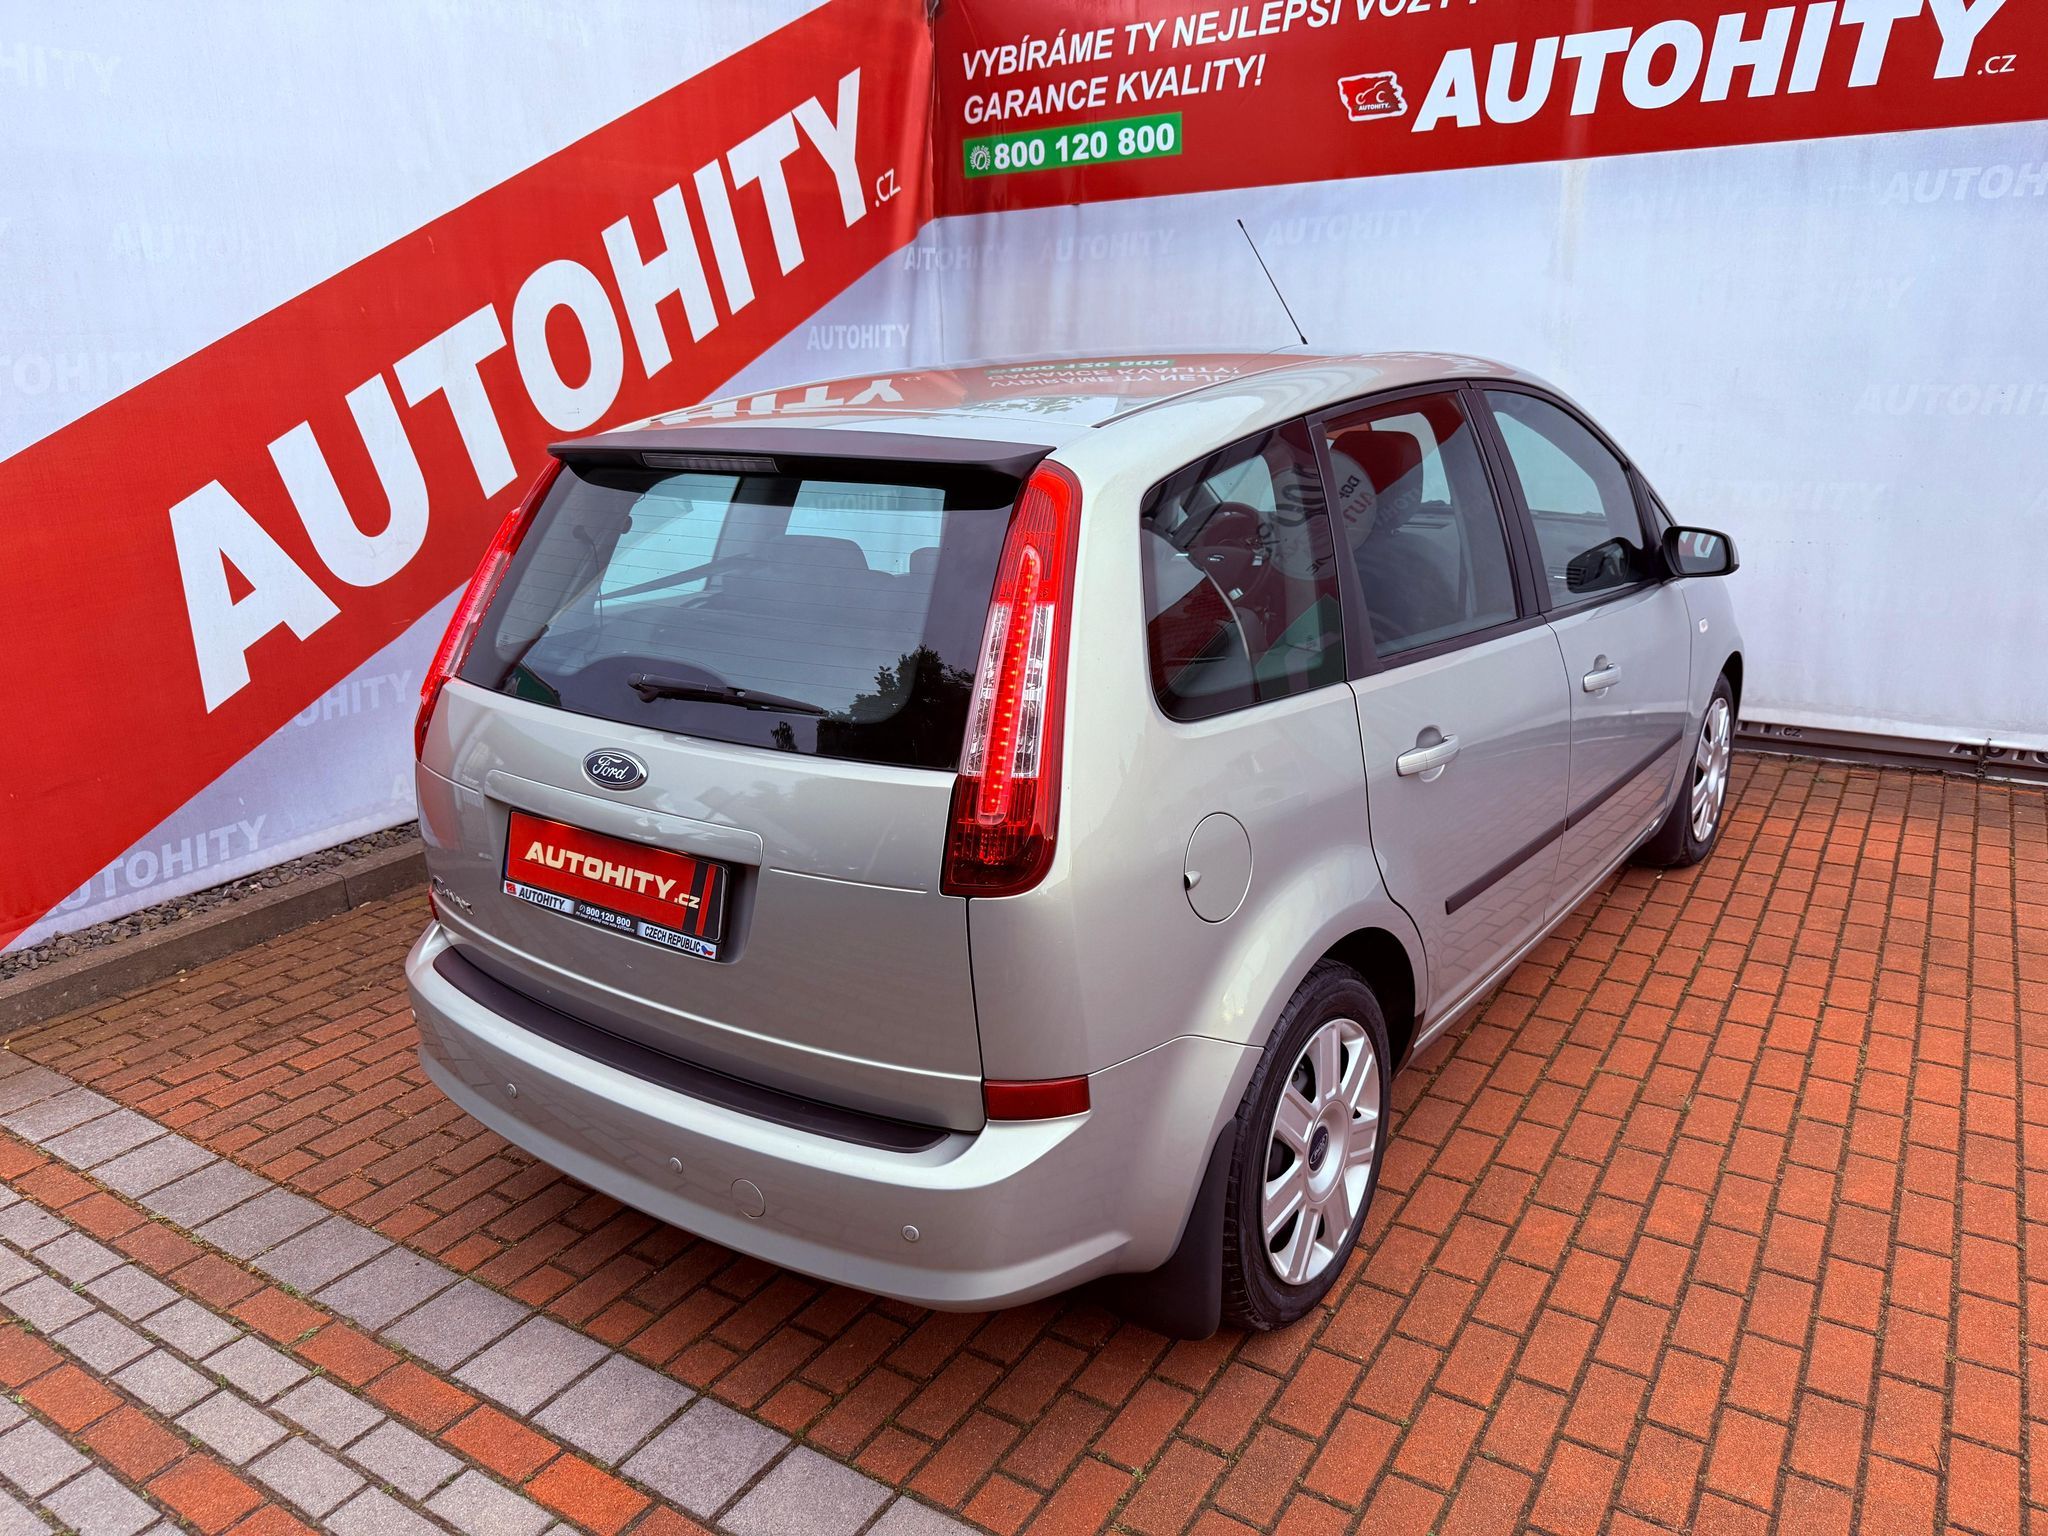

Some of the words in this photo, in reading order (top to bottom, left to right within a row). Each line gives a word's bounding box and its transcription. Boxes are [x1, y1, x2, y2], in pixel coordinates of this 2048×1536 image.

[962, 27, 1115, 81] VYBÍRÁME
[1124, 19, 1168, 56] TY
[963, 75, 1109, 126] GARANCE
[1116, 54, 1267, 104] KVALITY!
[994, 139, 1045, 170] 800
[1056, 131, 1109, 163] 120
[1118, 122, 1176, 155] 800
[806, 323, 911, 351] AUTOHITY
[592, 755, 630, 780] Ford
[585, 906, 601, 918] 800
[601, 911, 615, 923] 120
[616, 916, 631, 927] 800
[644, 926, 667, 942] CZECH
[667, 933, 701, 953] REPUBLIC
